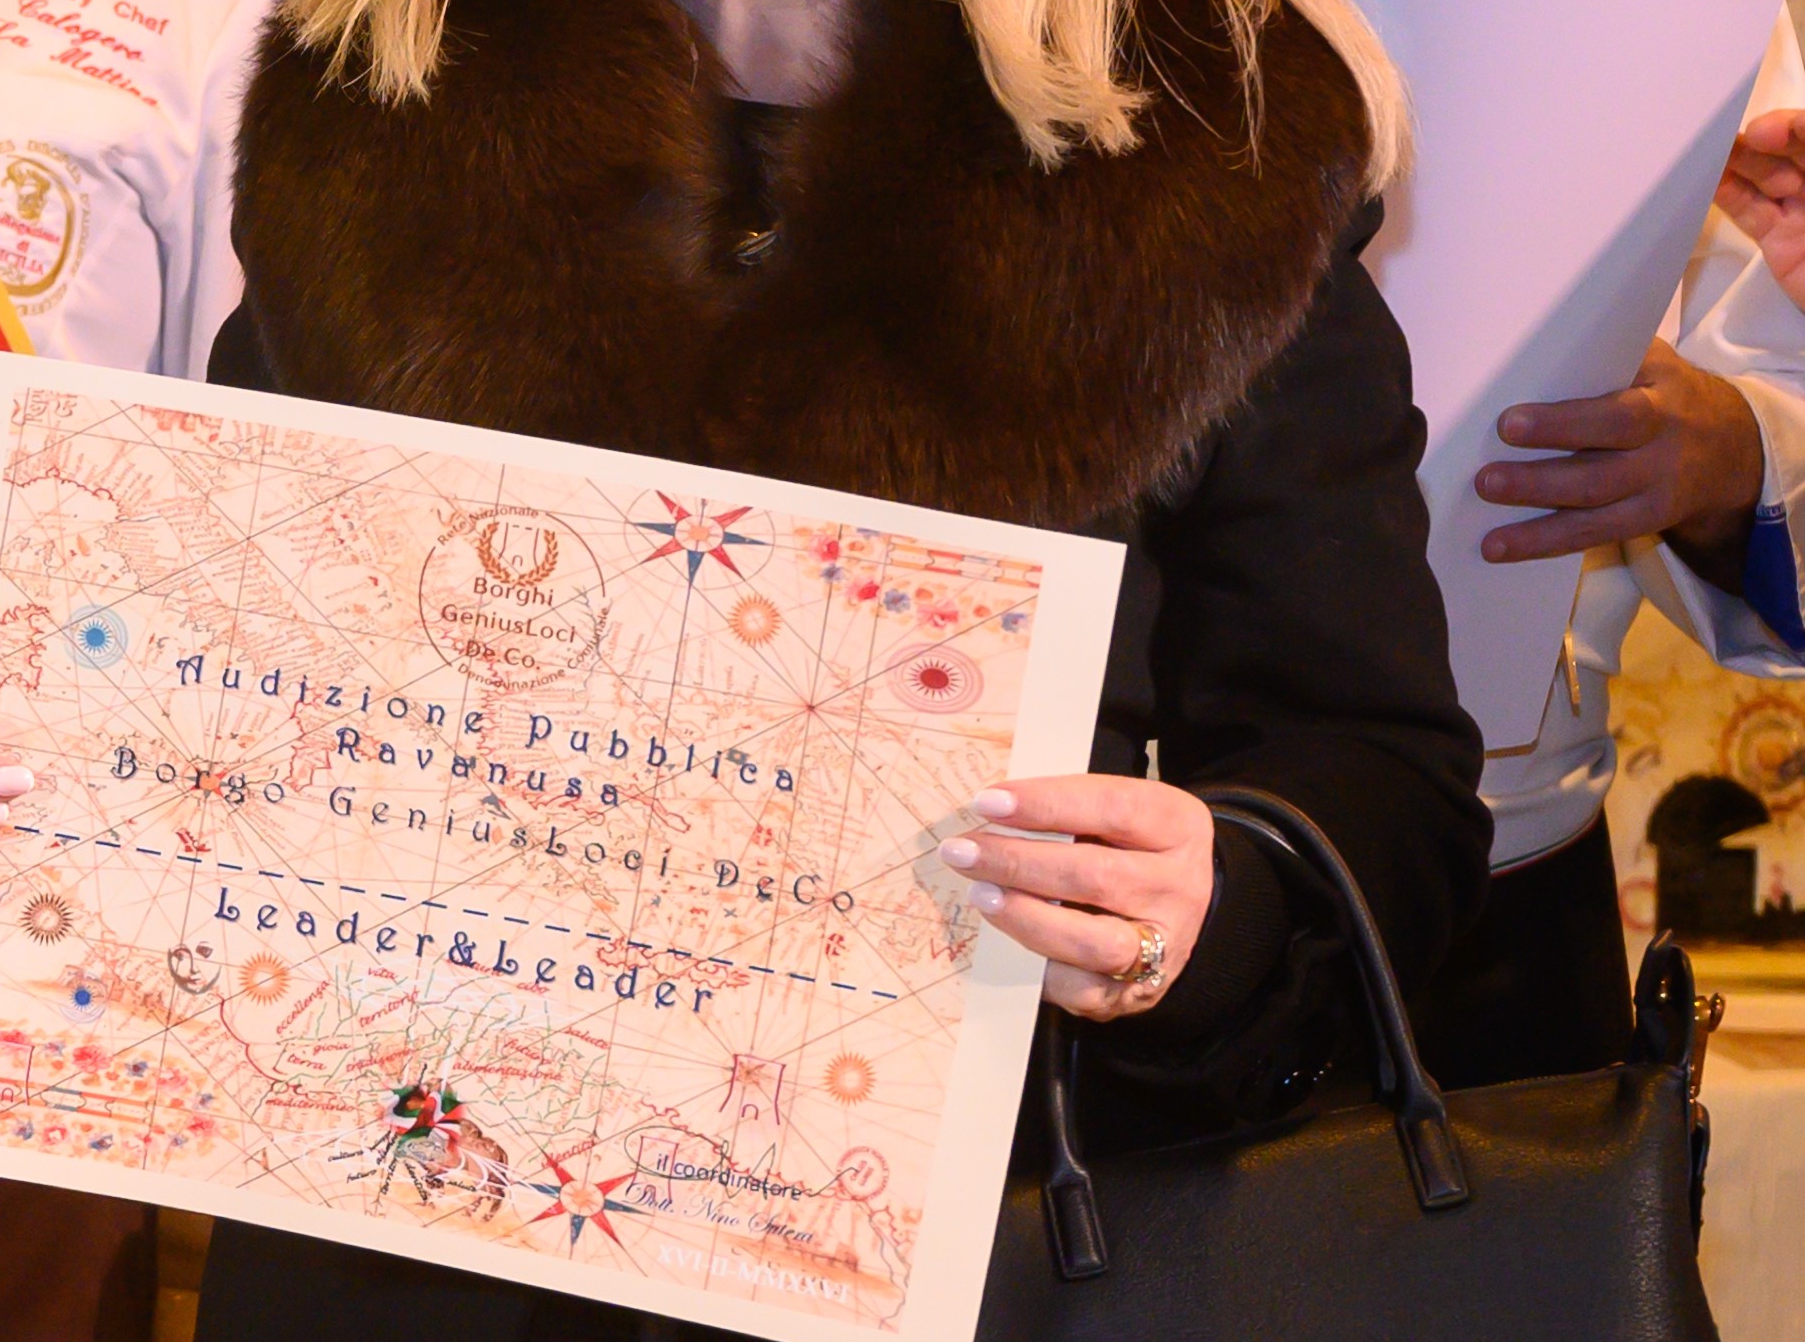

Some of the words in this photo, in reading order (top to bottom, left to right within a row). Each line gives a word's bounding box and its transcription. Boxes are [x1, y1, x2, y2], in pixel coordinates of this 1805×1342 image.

[113, 0, 170, 36] Chef
[437, 518, 468, 547] Rete
[469, 505, 540, 526] Nazionale
[473, 576, 555, 607] Borghi
[441, 603, 576, 643] GeniusLoci
[176, 655, 485, 733] Audizione
[110, 746, 286, 806] Borgo
[335, 726, 620, 808] Ravanusa
[213, 887, 714, 1013] Leader&Leader
[515, 980, 551, 995] cibo
[276, 980, 330, 1036] eccellenza
[313, 1042, 350, 1056] gioia
[562, 1025, 611, 1051] salute
[287, 1054, 327, 1071] terra
[656, 1152, 668, 1173] il
[674, 1160, 802, 1201] coordinatore
[683, 1193, 741, 1228] Nino
